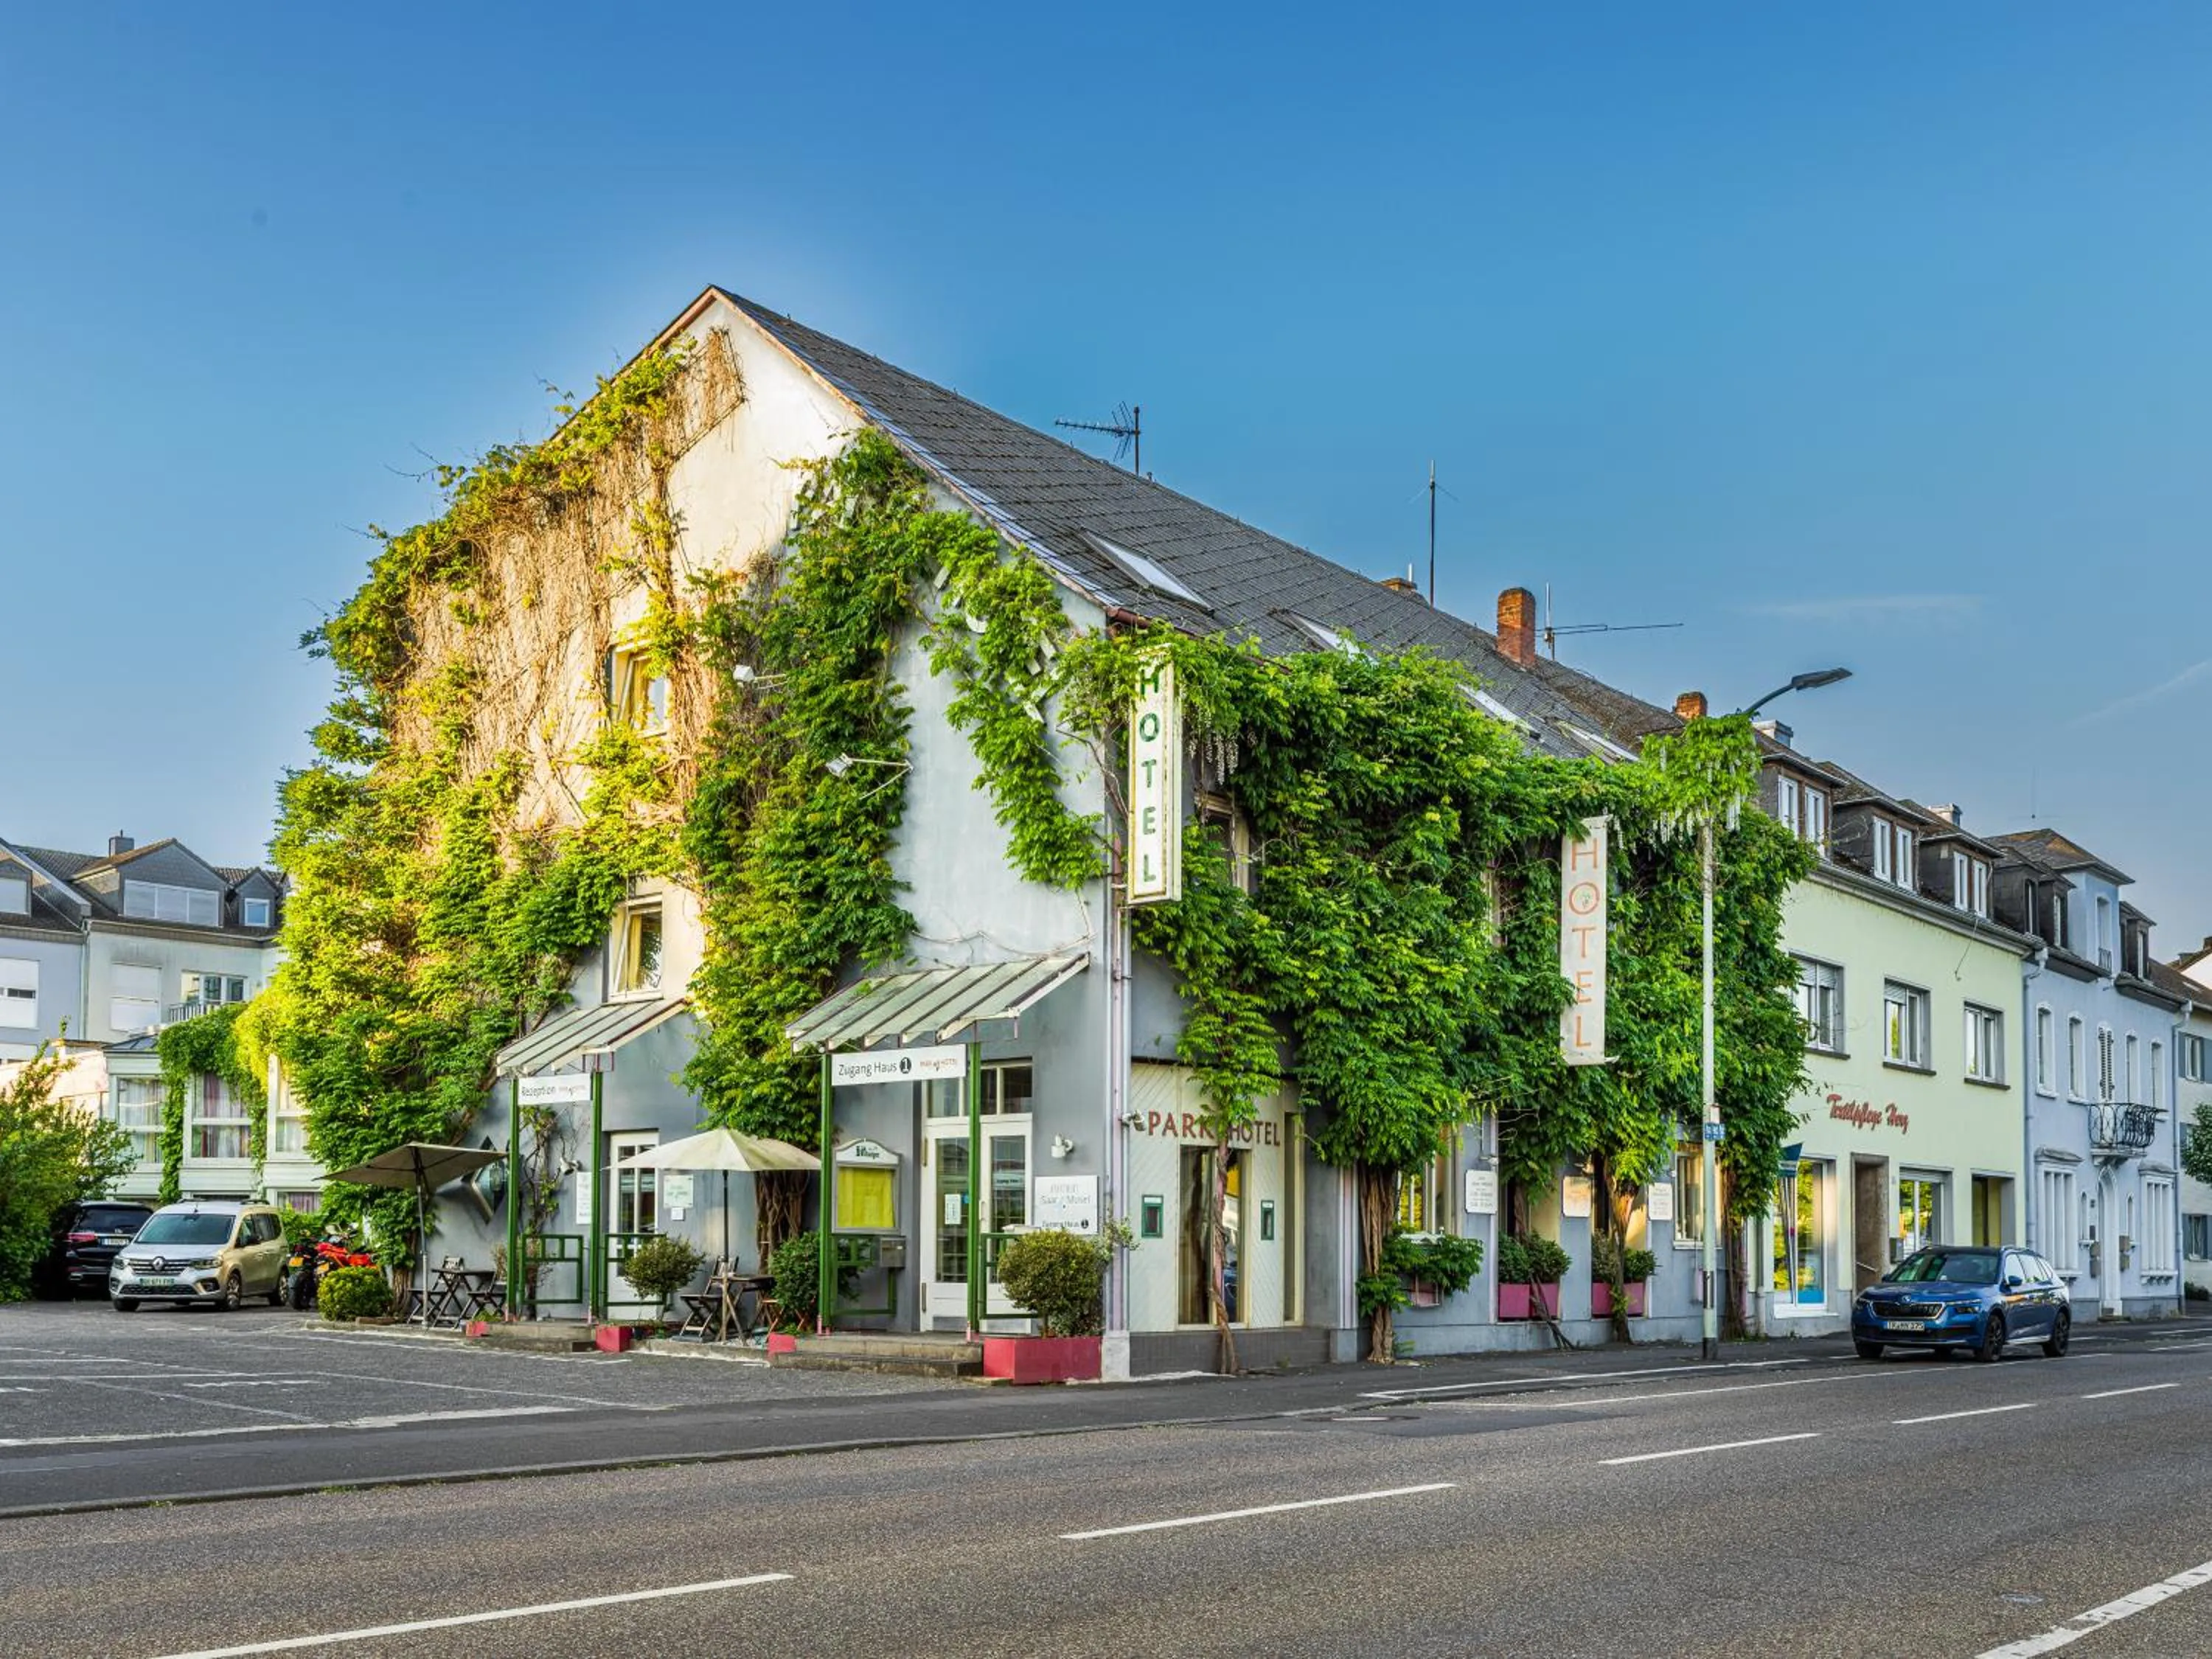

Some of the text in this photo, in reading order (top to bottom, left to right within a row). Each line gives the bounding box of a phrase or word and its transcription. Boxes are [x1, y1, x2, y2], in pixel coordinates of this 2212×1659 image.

[1139, 669, 1161, 883] HOTEL
[1568, 837, 1600, 1047] HOTEL
[838, 1063, 873, 1079] Zugang
[874, 1061, 897, 1074] Haus
[1147, 1108, 1216, 1140] PARK
